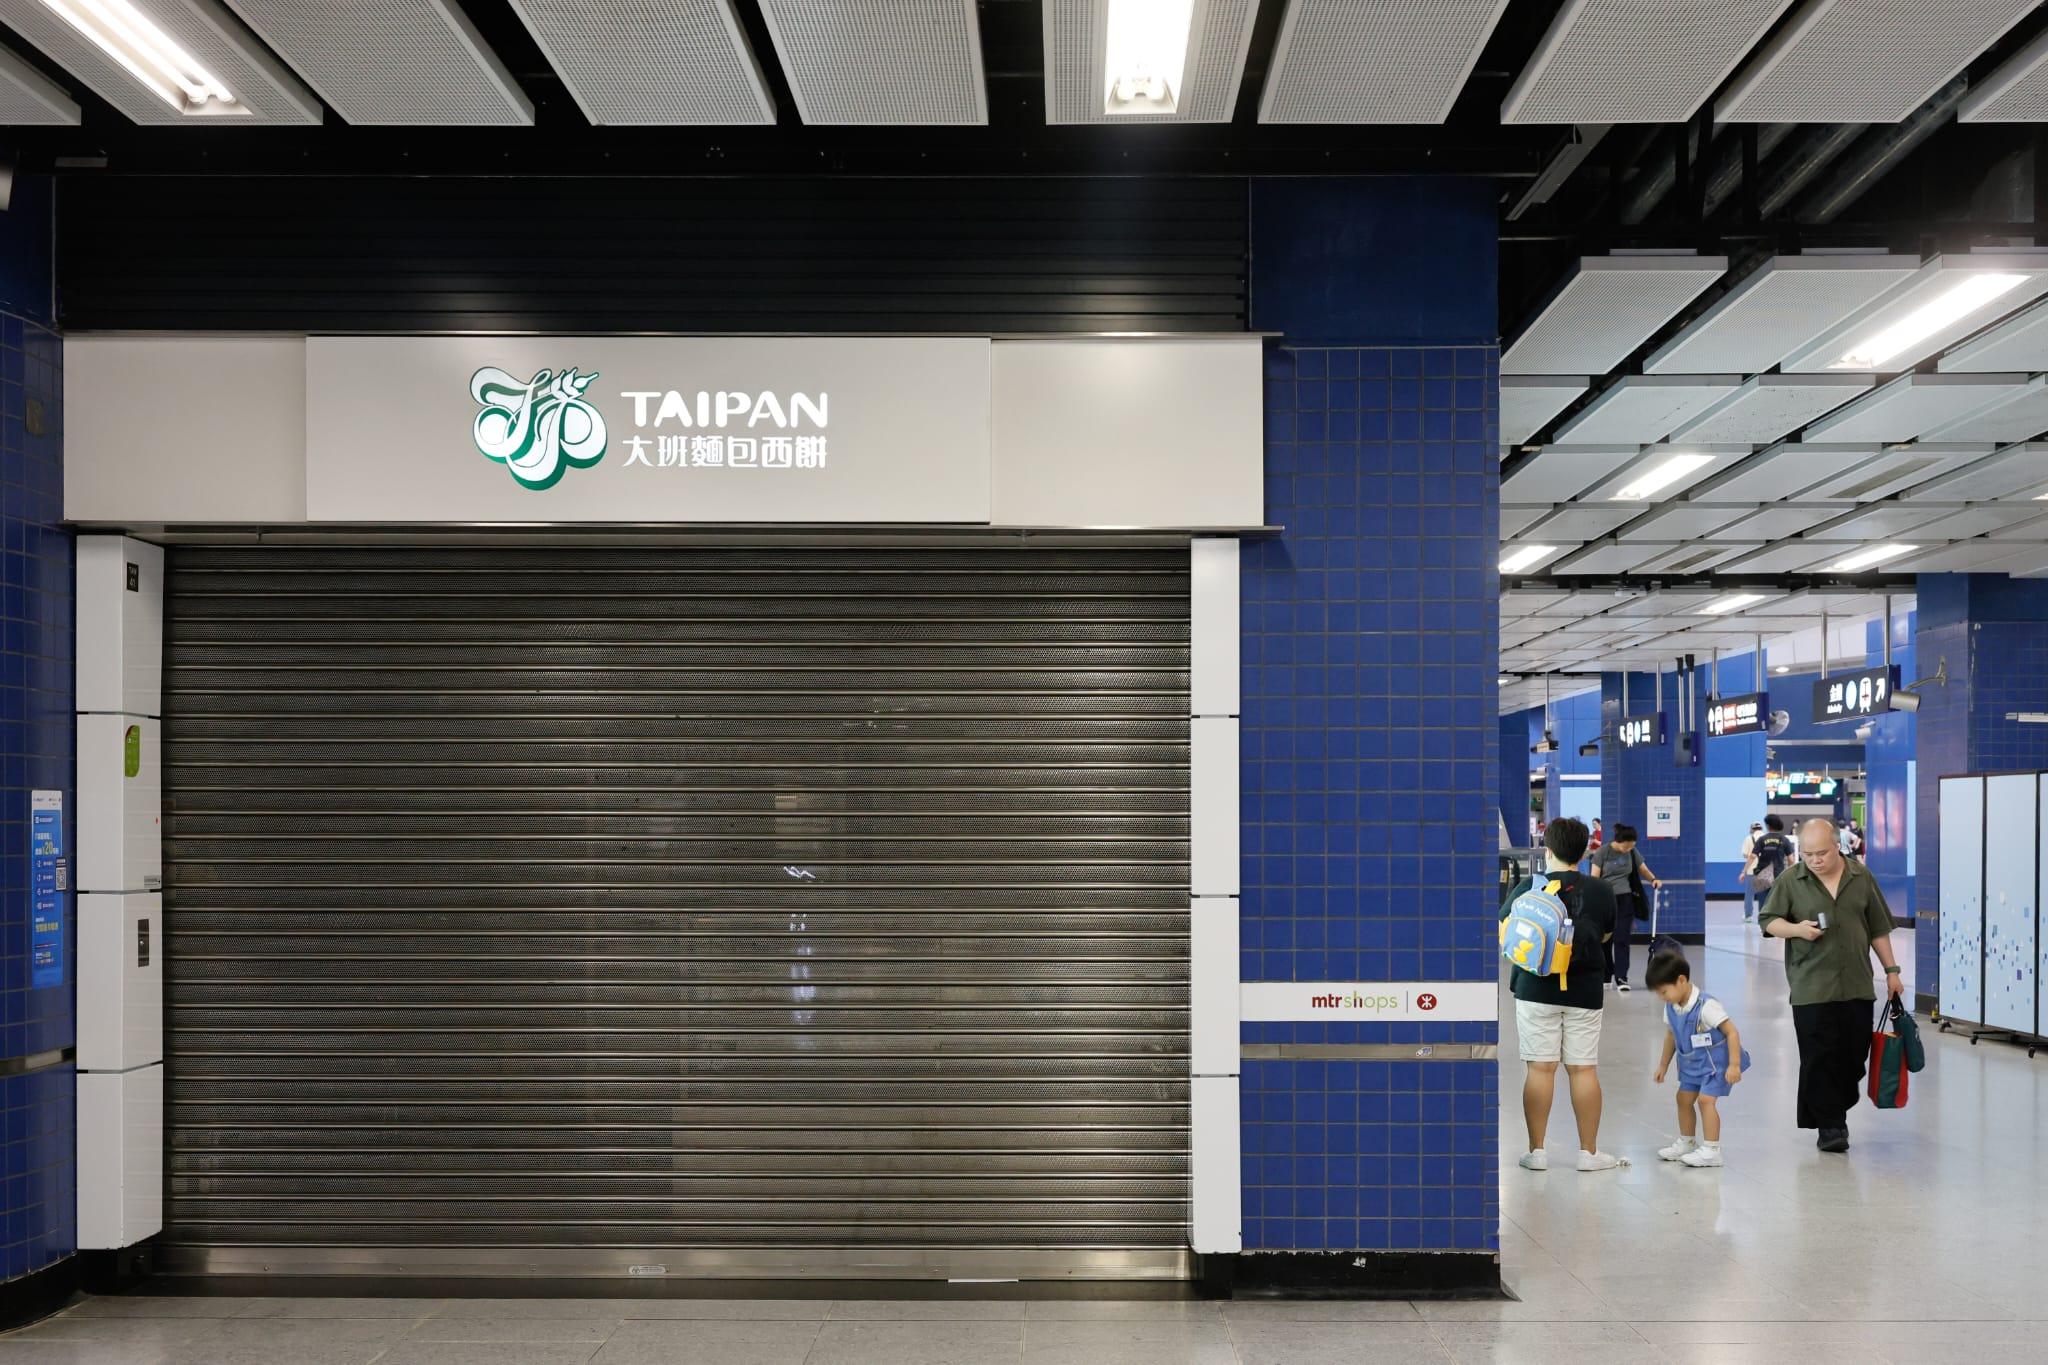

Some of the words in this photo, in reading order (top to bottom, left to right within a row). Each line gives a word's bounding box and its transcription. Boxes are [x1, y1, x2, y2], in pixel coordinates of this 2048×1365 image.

[620, 390, 828, 428] TAIPAN
[622, 435, 827, 469] 大班麵包西餅
